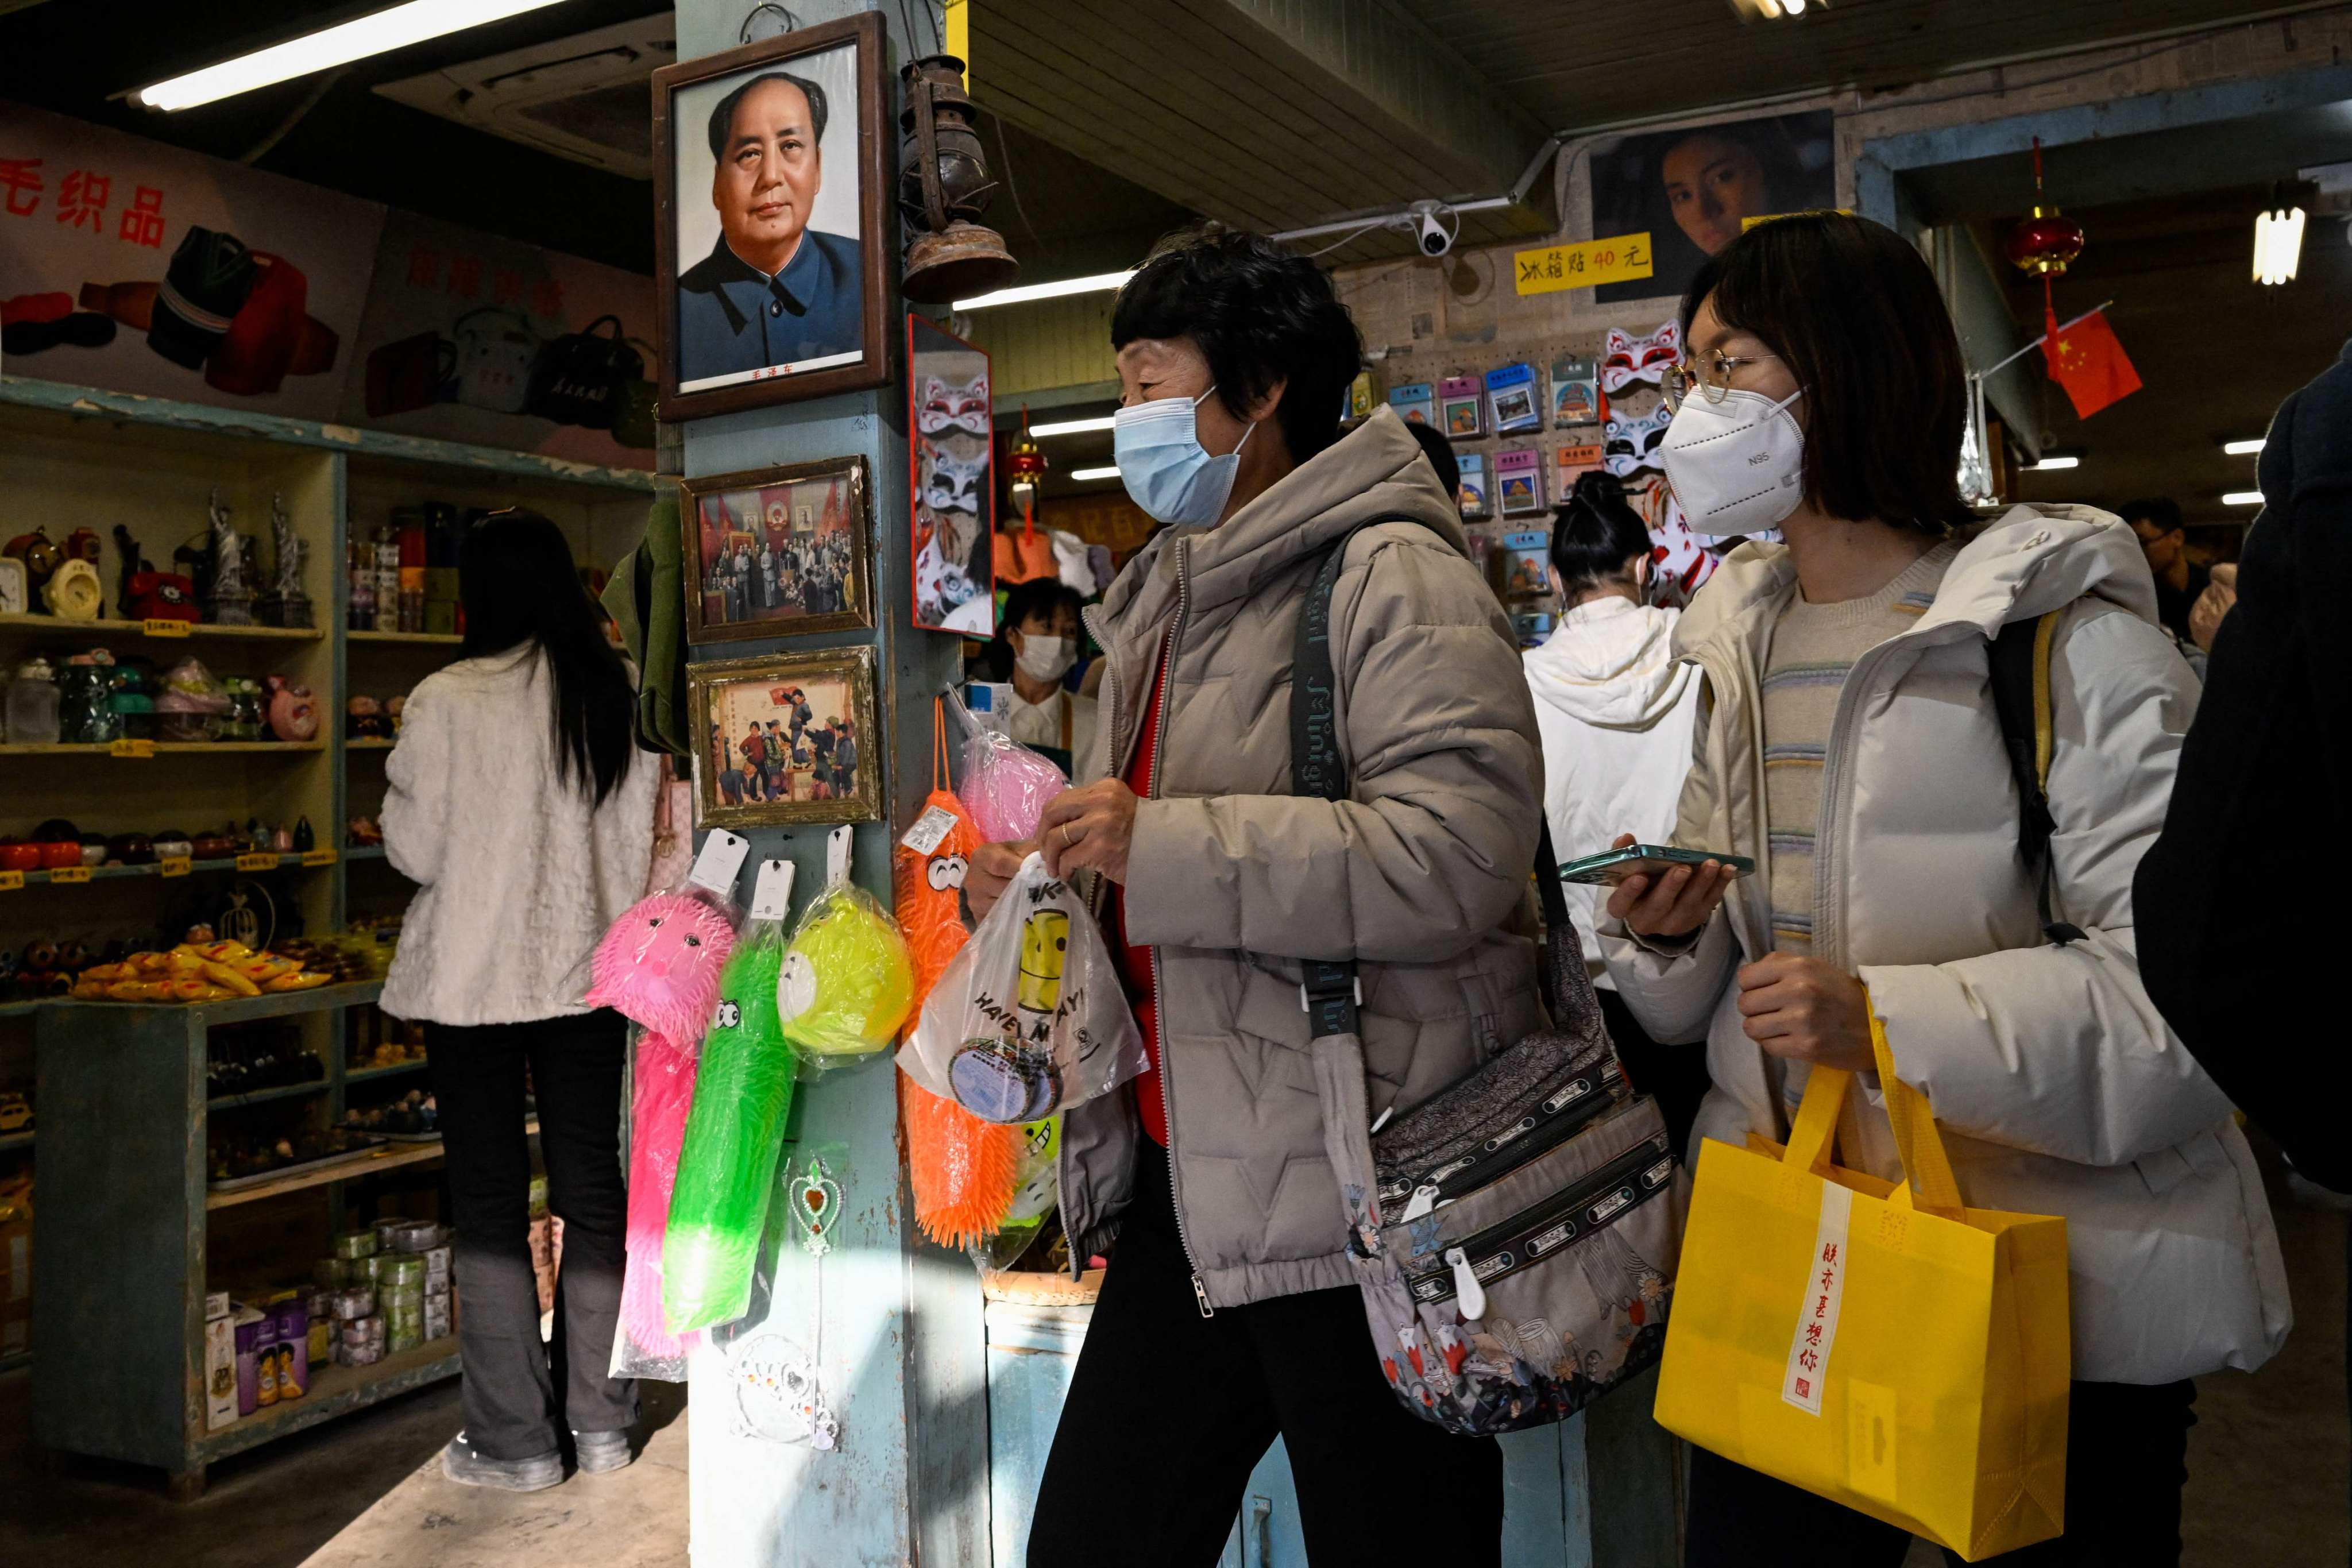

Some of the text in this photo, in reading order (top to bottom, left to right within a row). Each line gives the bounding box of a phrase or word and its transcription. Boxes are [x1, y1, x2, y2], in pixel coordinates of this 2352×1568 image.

[0, 158, 165, 249] 毛织品
[752, 364, 793, 380] 毛泽东
[1747, 451, 1770, 466] N95
[1799, 1242, 1838, 1373] 朕亦甚想你
